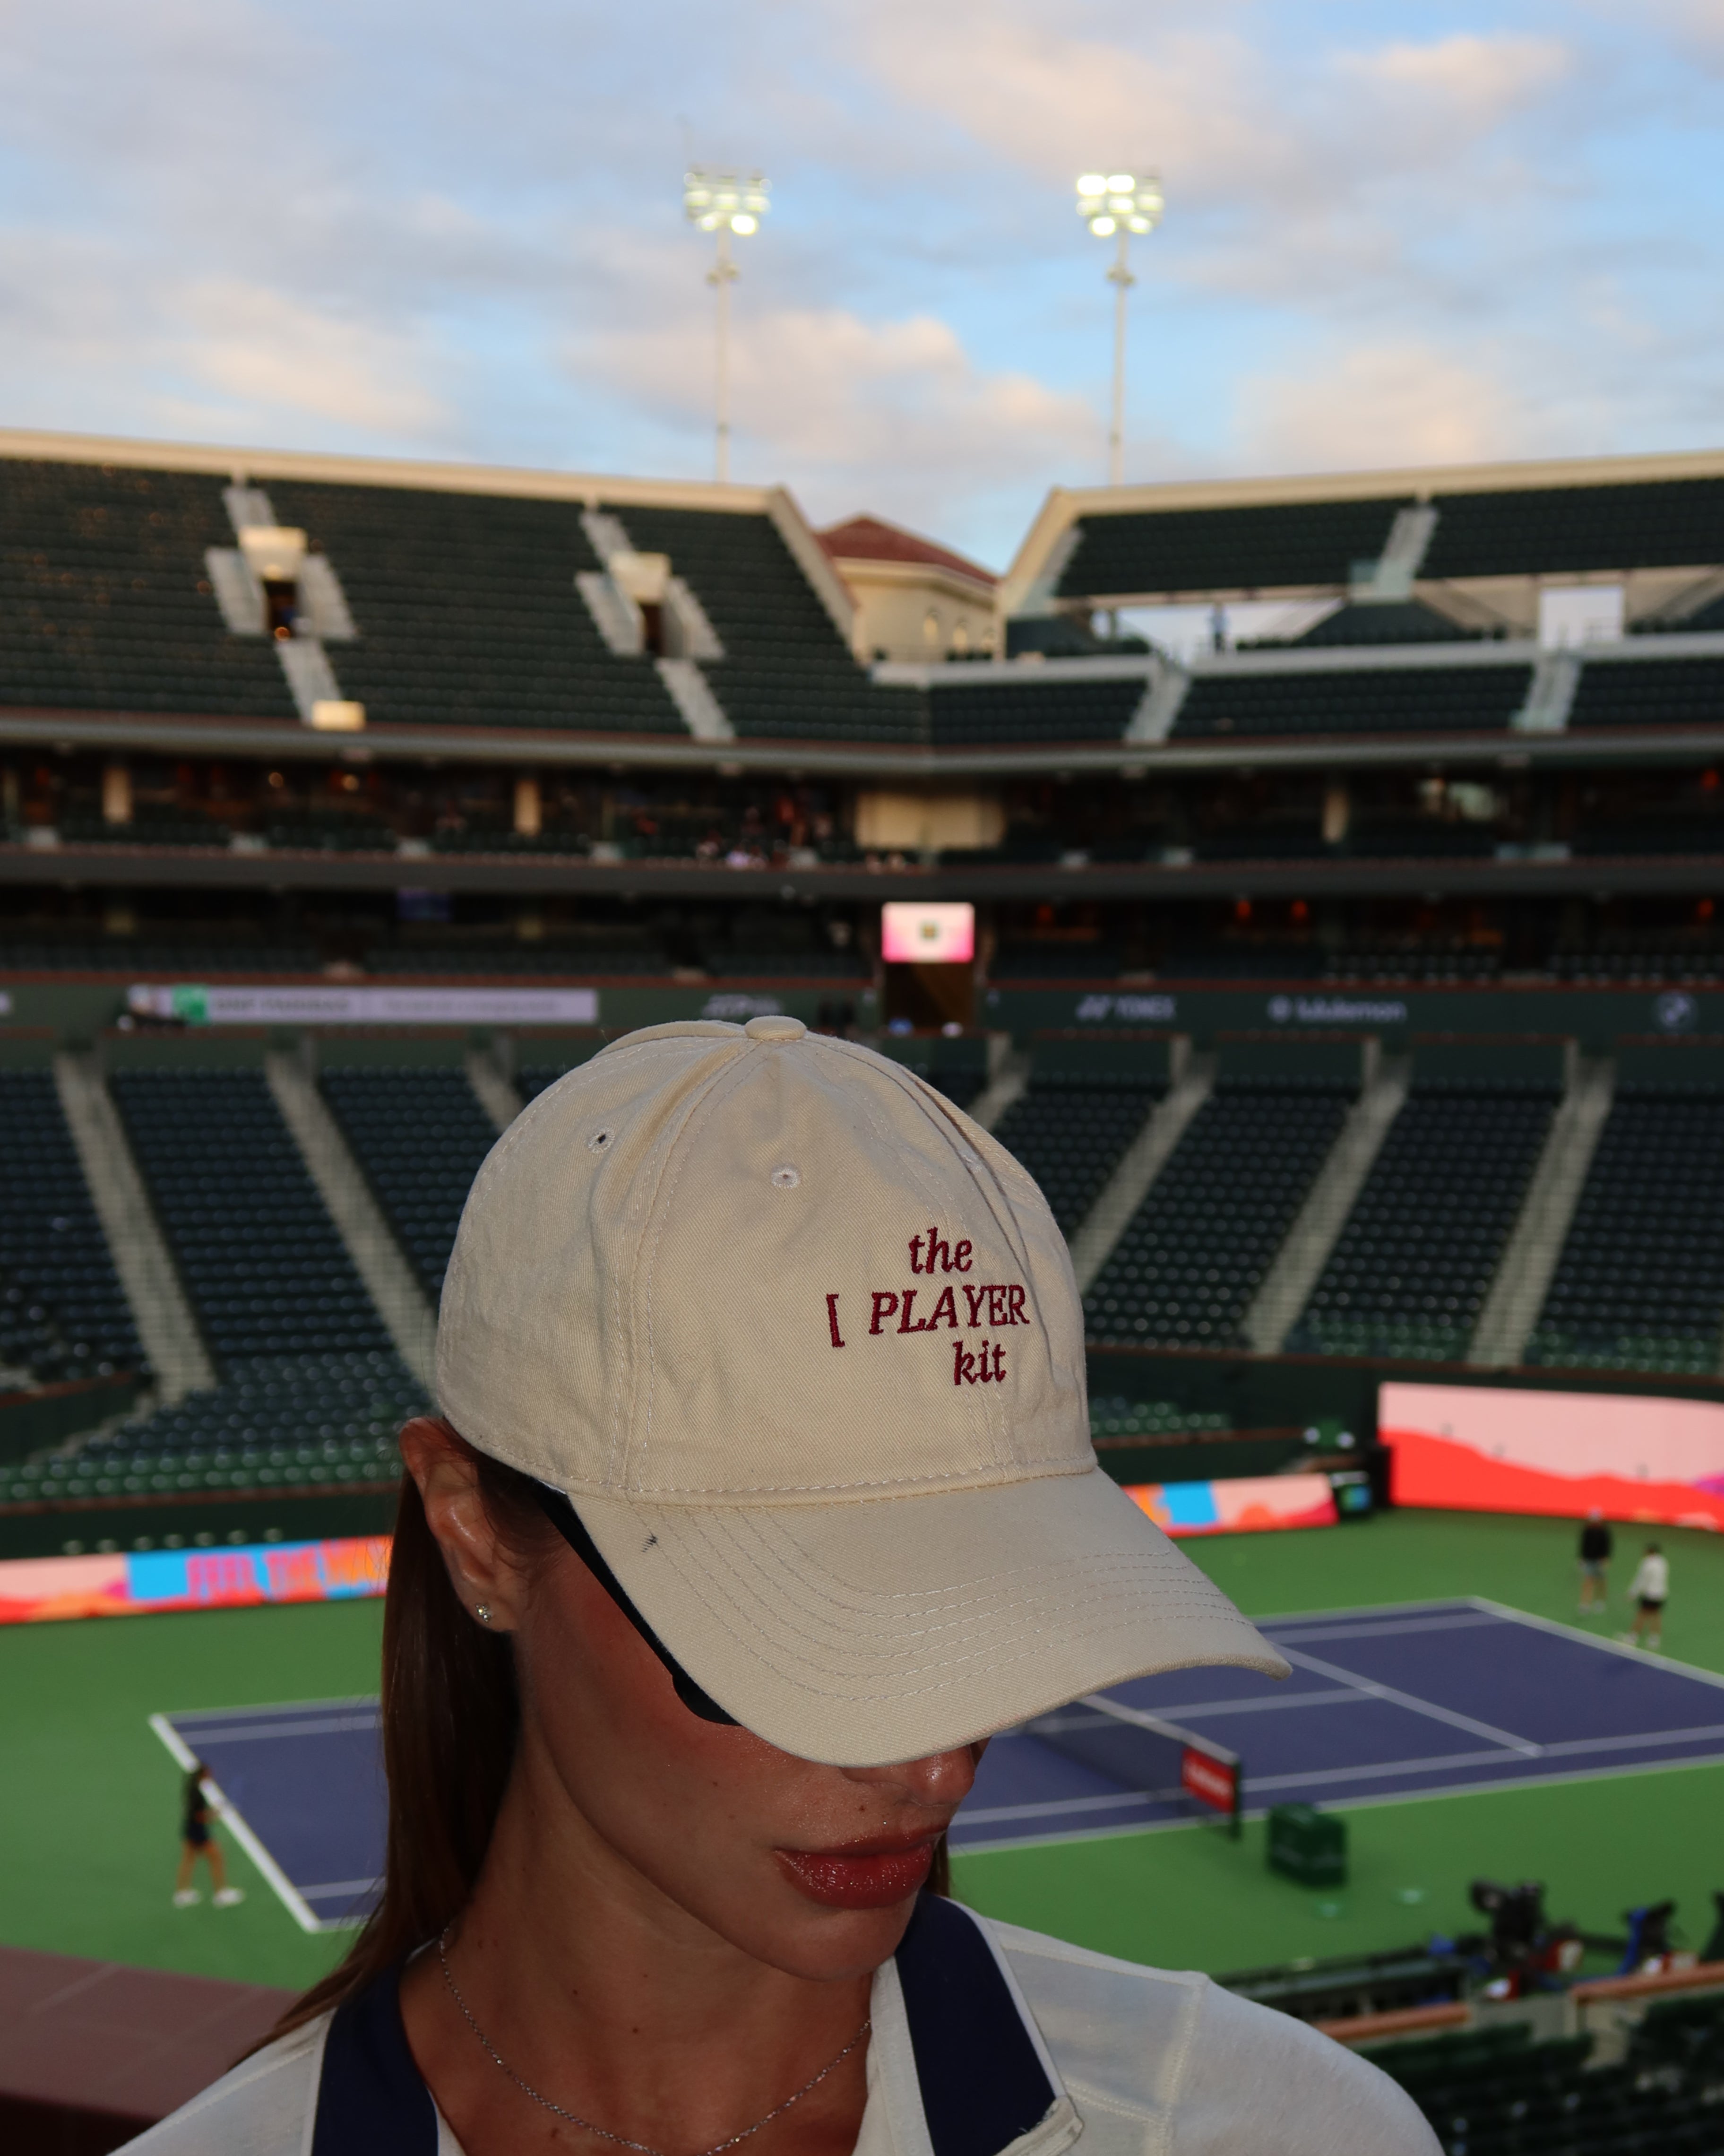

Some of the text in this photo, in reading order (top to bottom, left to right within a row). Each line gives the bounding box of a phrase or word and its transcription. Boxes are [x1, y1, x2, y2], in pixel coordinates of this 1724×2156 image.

[908, 1226, 972, 1274] the
[869, 1284, 1030, 1334] PLAYER
[952, 1340, 1006, 1385] kit
